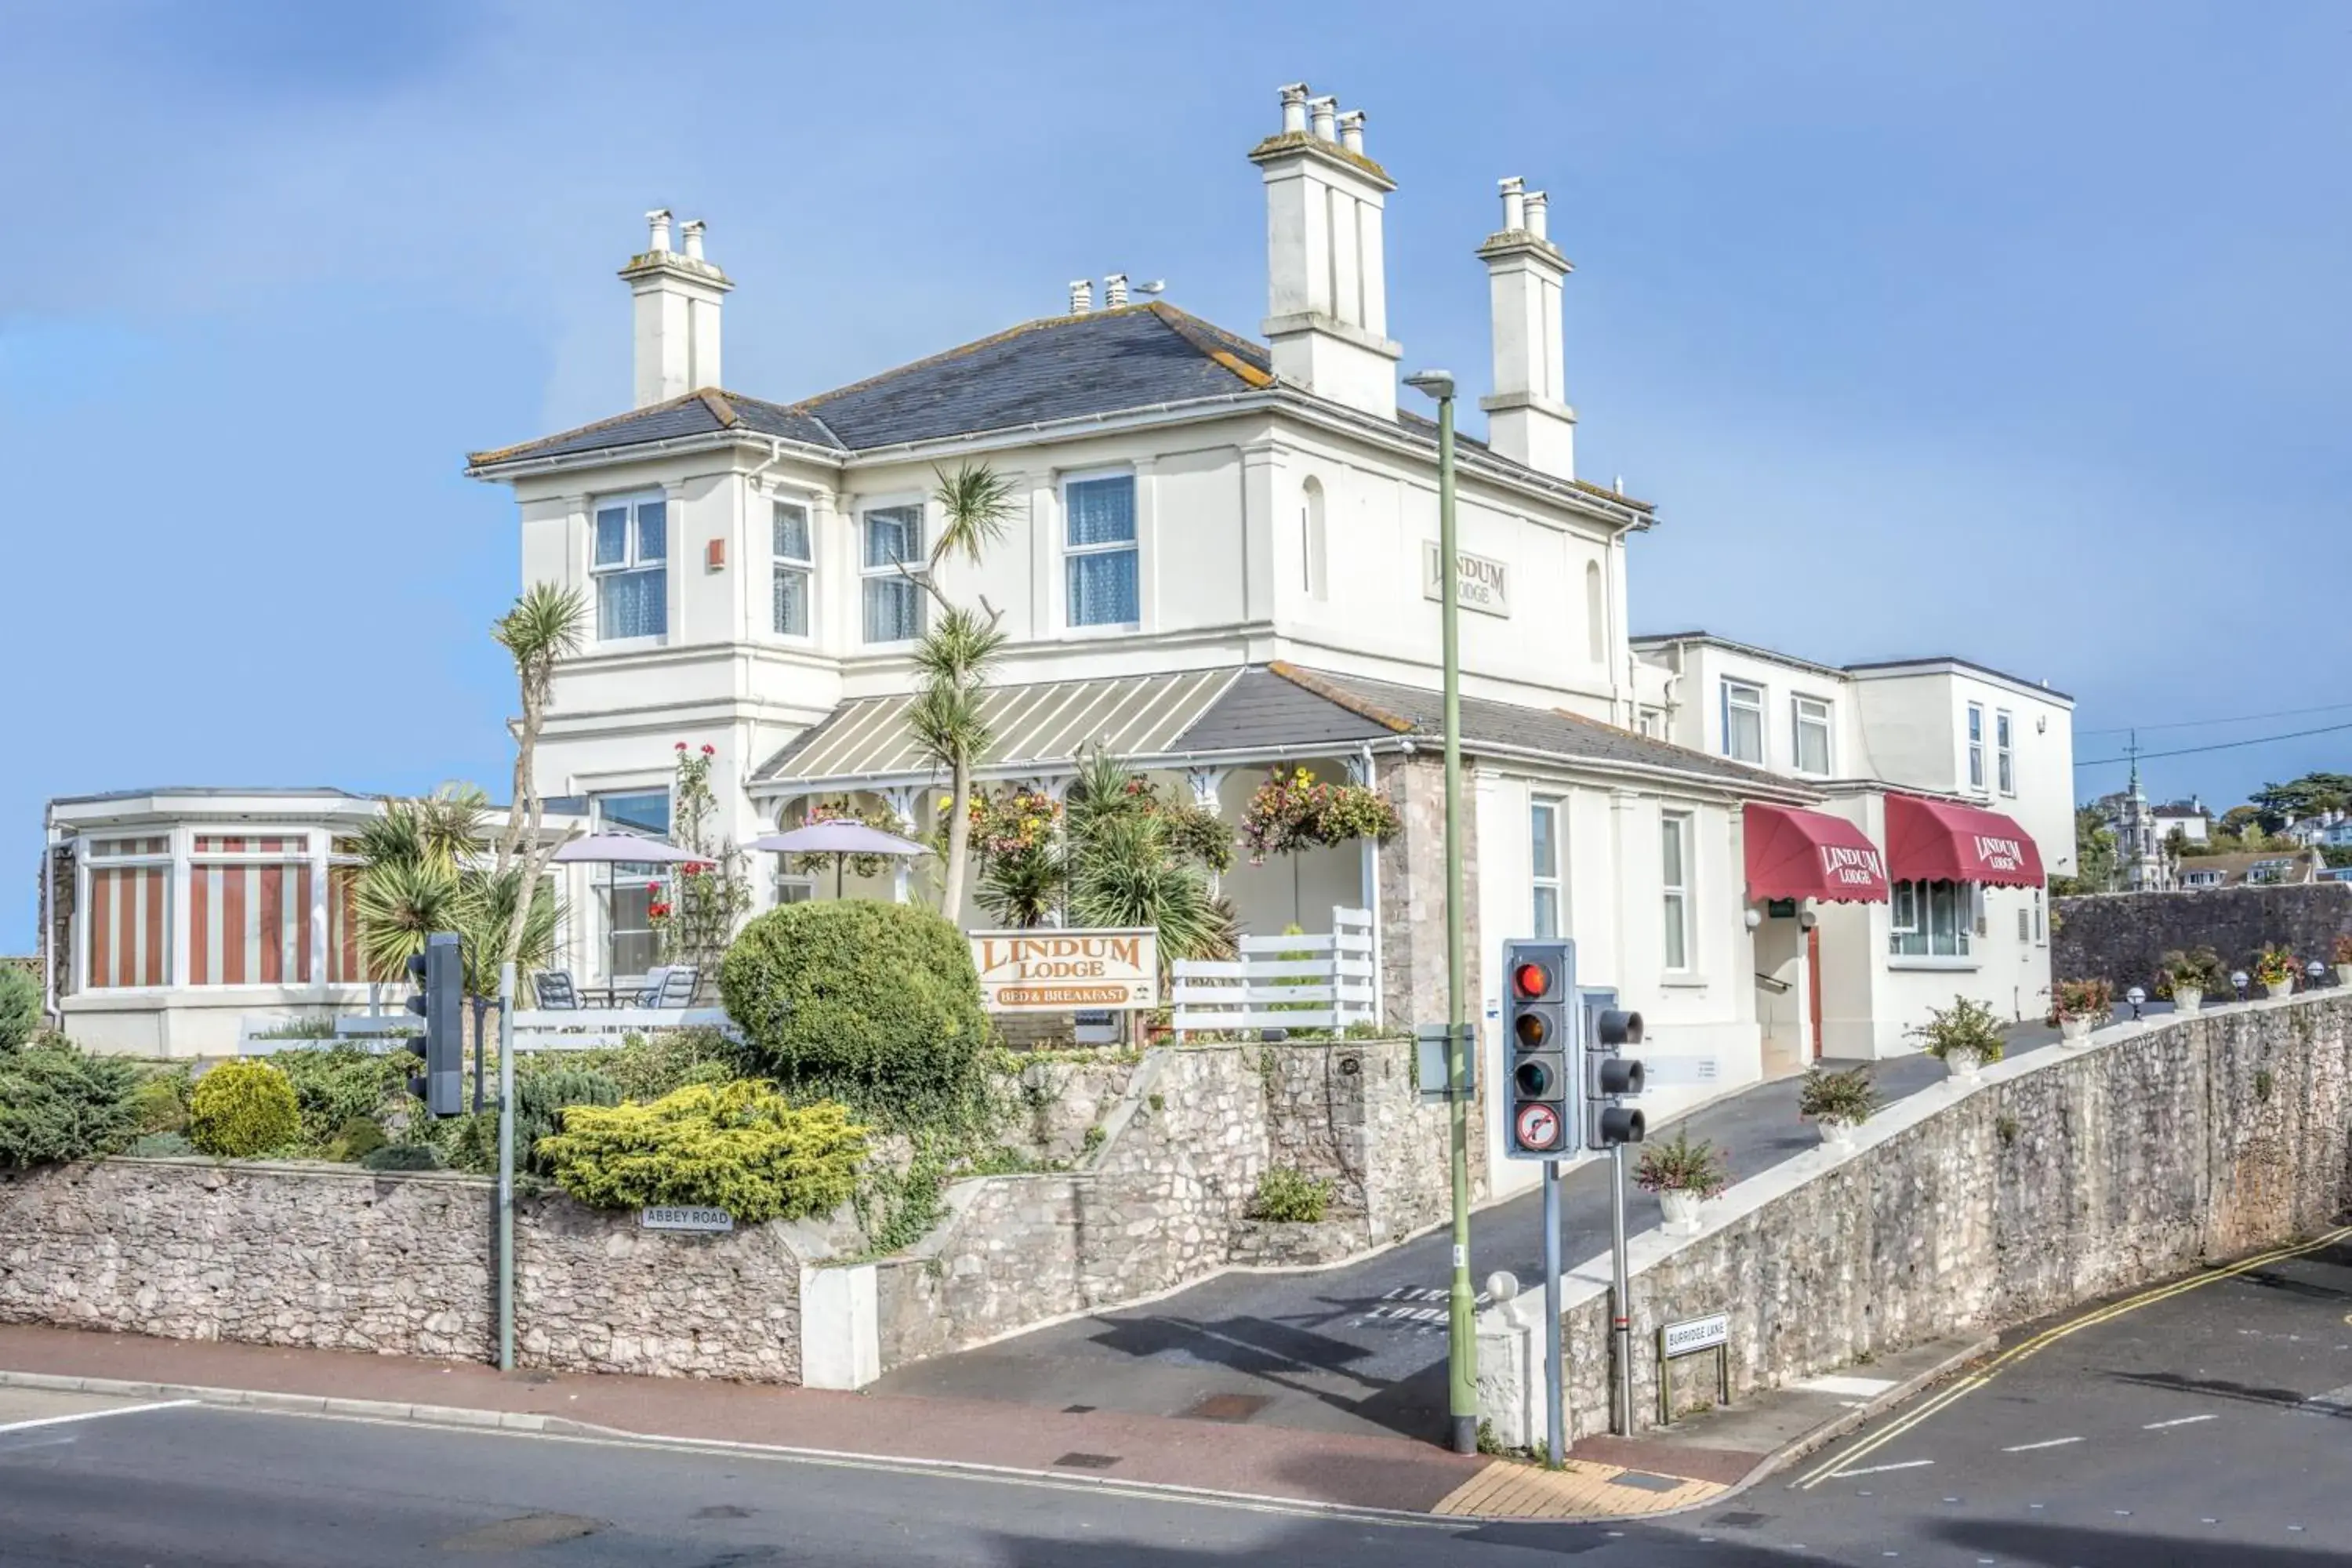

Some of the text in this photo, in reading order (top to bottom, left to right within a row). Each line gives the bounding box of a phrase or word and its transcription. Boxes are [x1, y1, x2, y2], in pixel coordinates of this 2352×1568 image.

[1431, 548, 1506, 604] LNDUM
[1457, 580, 1490, 604] ODGE
[1821, 846, 1882, 879] LINDUM
[1974, 836, 2024, 866] LINDUM
[1990, 856, 2016, 870] LODGE
[1838, 868, 1872, 884] LODGE
[982, 938, 1141, 975] LINDUM
[1020, 961, 1105, 978] LODGE
[1000, 989, 1124, 1002] BED & BREAKFAST
[648, 1210, 728, 1224] ABBEY ROAD
[1669, 1321, 1724, 1346] BURRIDGE LANE
